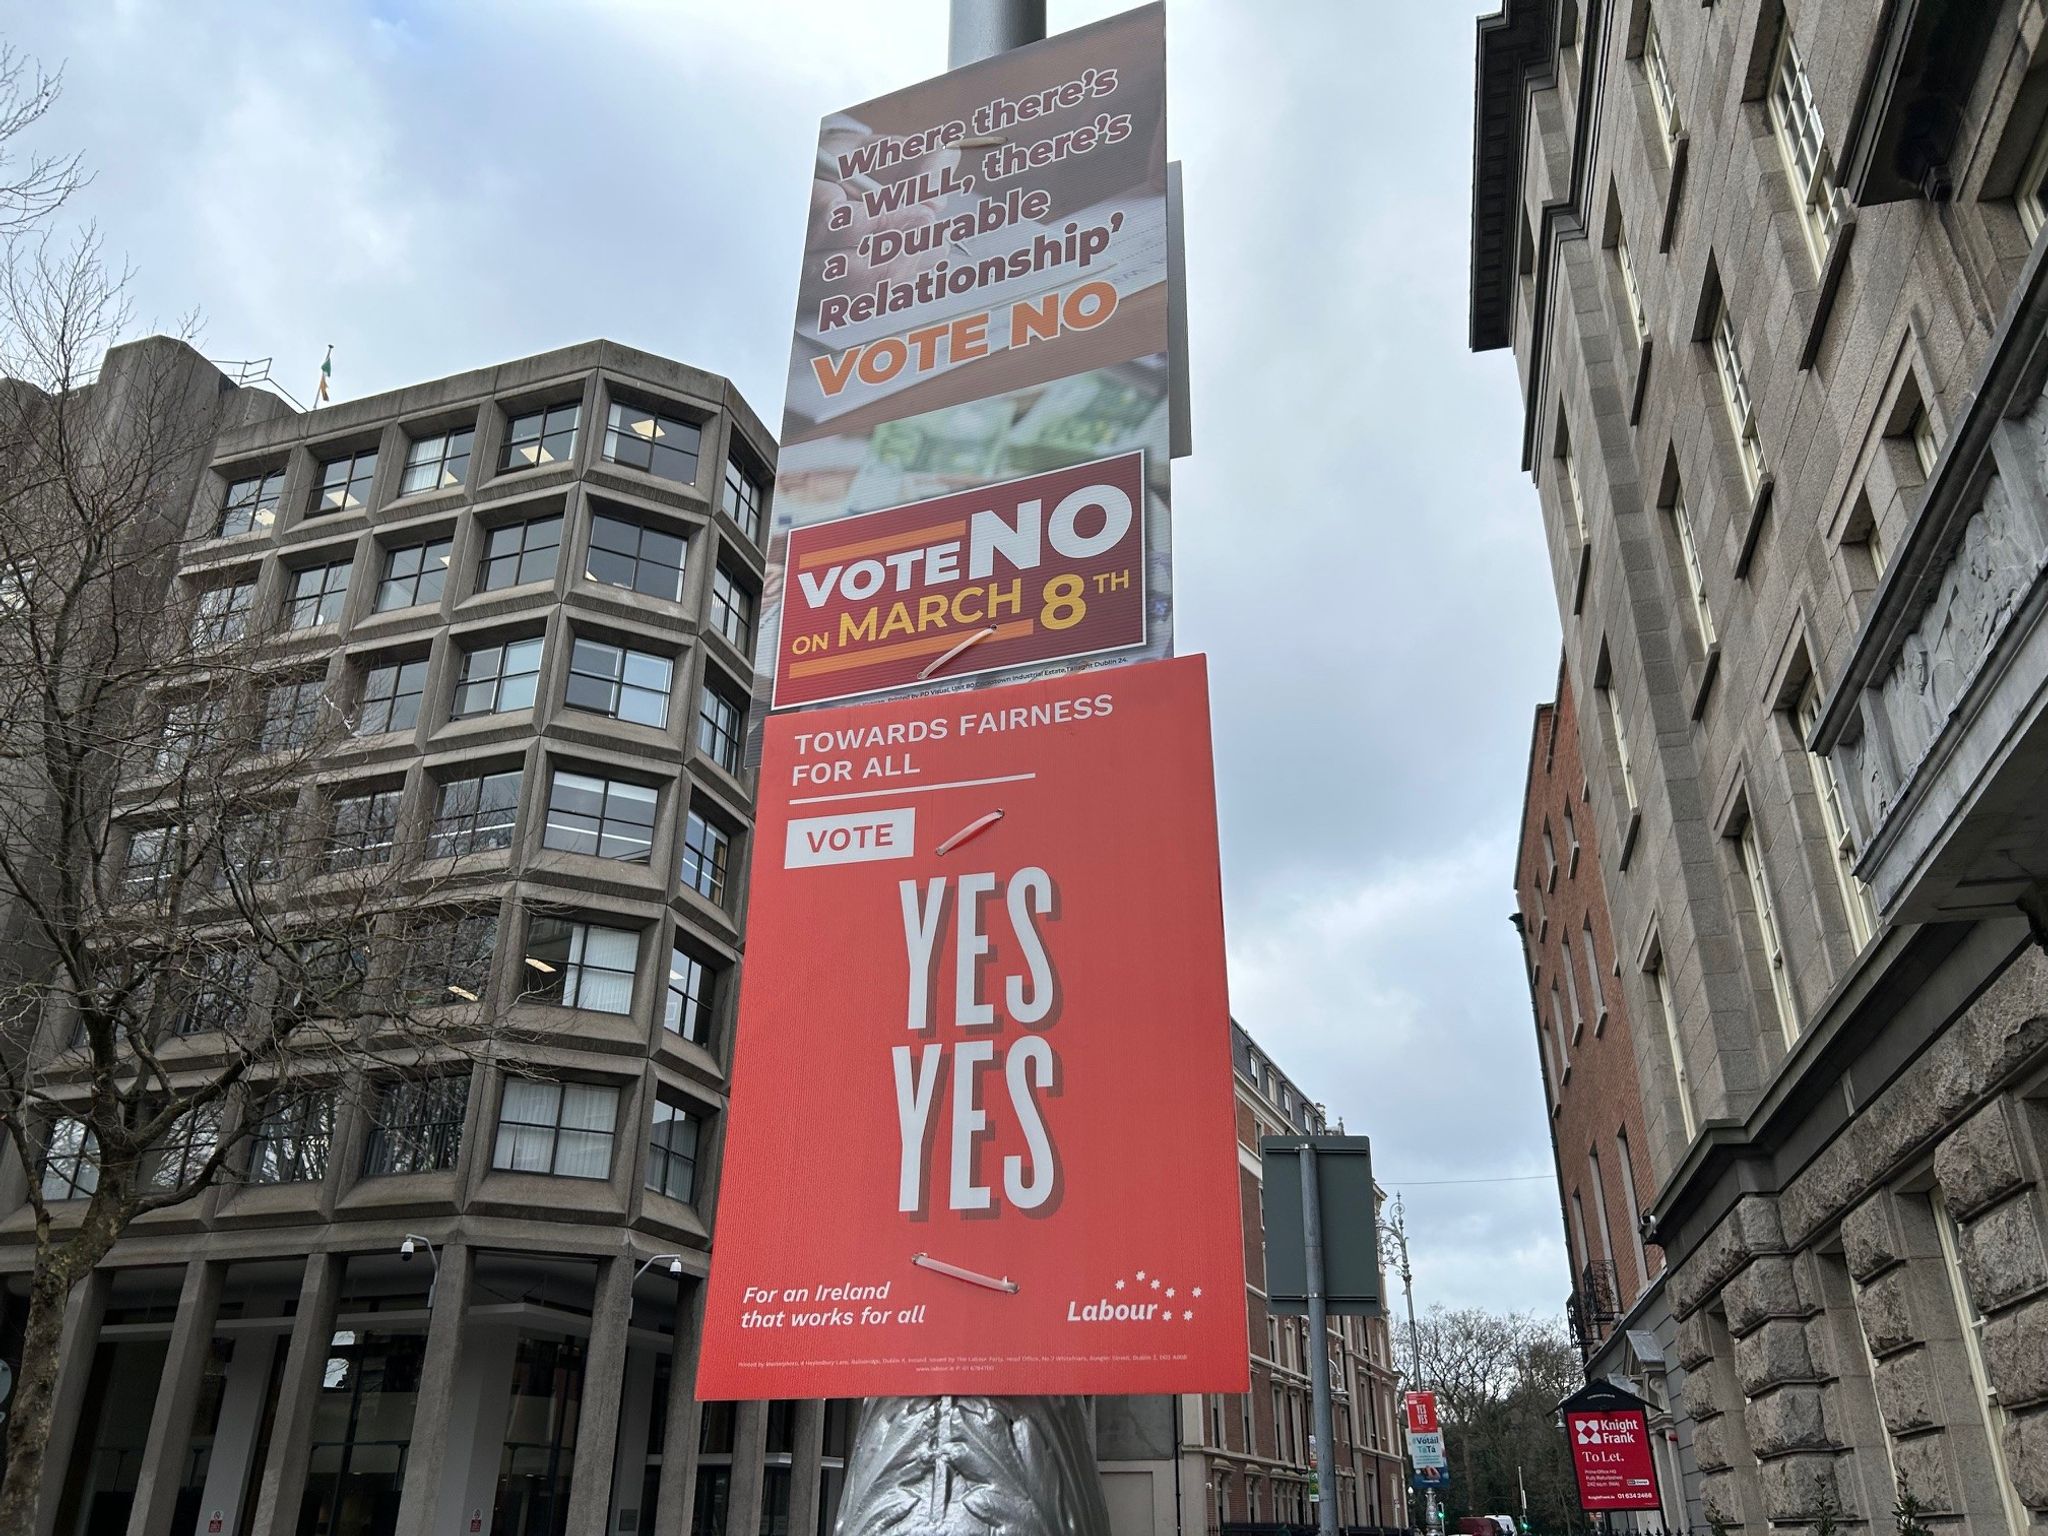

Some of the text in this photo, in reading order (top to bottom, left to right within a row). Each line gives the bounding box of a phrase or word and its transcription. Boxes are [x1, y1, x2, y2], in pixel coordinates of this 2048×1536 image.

[837, 68, 1118, 180] Where there’s
[828, 113, 1132, 230] a WILL, there’s
[822, 253, 846, 282] a
[809, 280, 1119, 397] VOTE NO
[797, 484, 1133, 609] VOTE NO
[791, 631, 829, 656] ON
[837, 577, 1022, 647] MARCH
[1094, 659, 1116, 667] Dublin
[795, 694, 1114, 755] TOWARDS FAIRNESS
[792, 753, 921, 787] FOR ALL
[806, 823, 894, 854] VOTE
[899, 866, 1054, 1030] YES
[892, 1036, 1055, 1212] YES
[742, 1281, 891, 1304] For an Ireland
[741, 1304, 926, 1329] that works for all
[1067, 1299, 1158, 1322] Labour
[1600, 1418, 1639, 1433] Knight
[1602, 1432, 1635, 1444] Frank
[1582, 1450, 1625, 1462] To Let.
